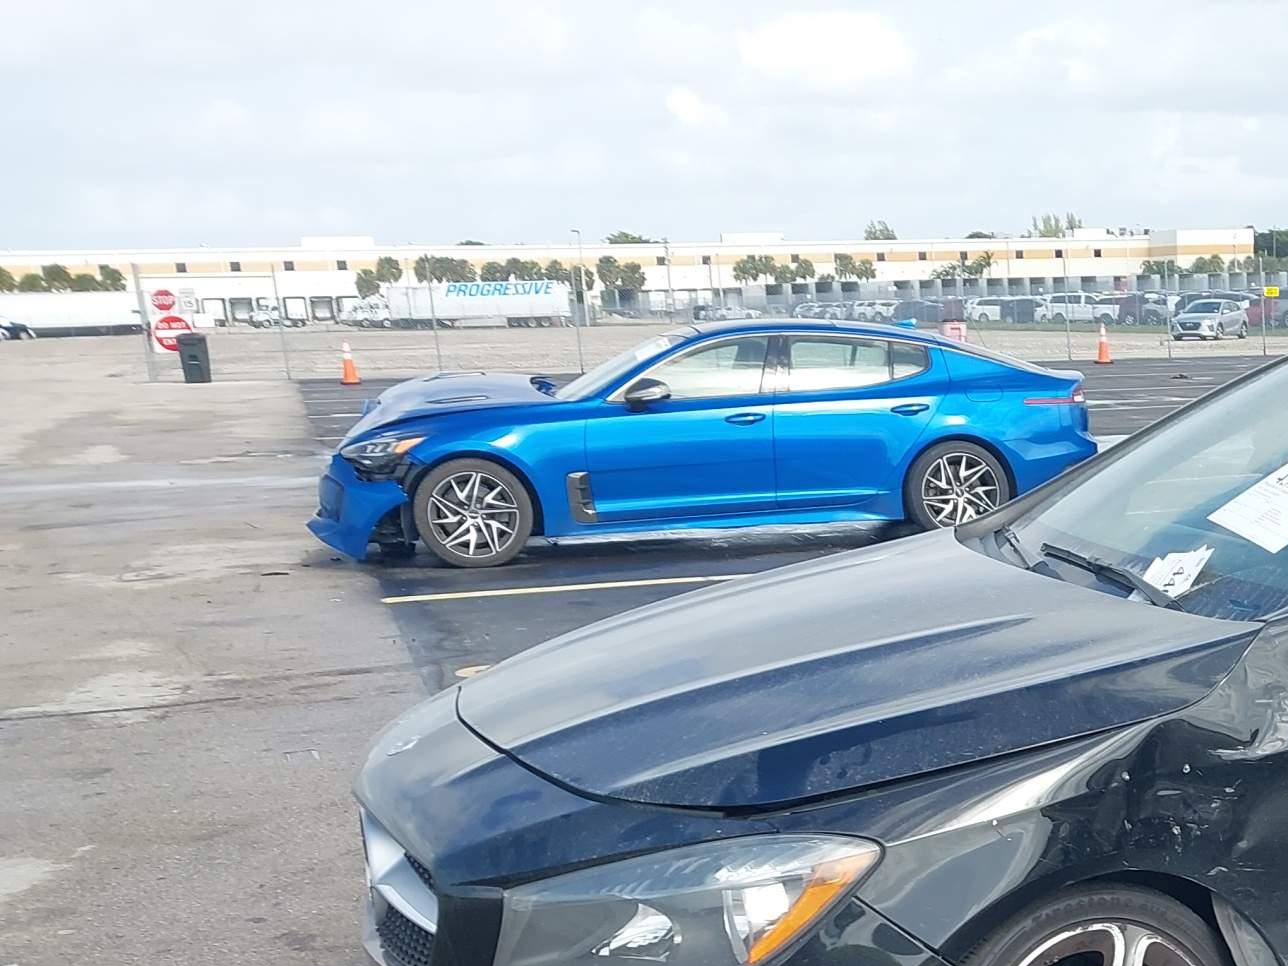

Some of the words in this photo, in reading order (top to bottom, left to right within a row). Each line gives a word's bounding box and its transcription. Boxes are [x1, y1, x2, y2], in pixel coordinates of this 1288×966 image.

[445, 281, 553, 297] PROGRESSIVE
[152, 295, 175, 305] STOP
[157, 321, 169, 329] DO
[171, 321, 187, 329] NOT
